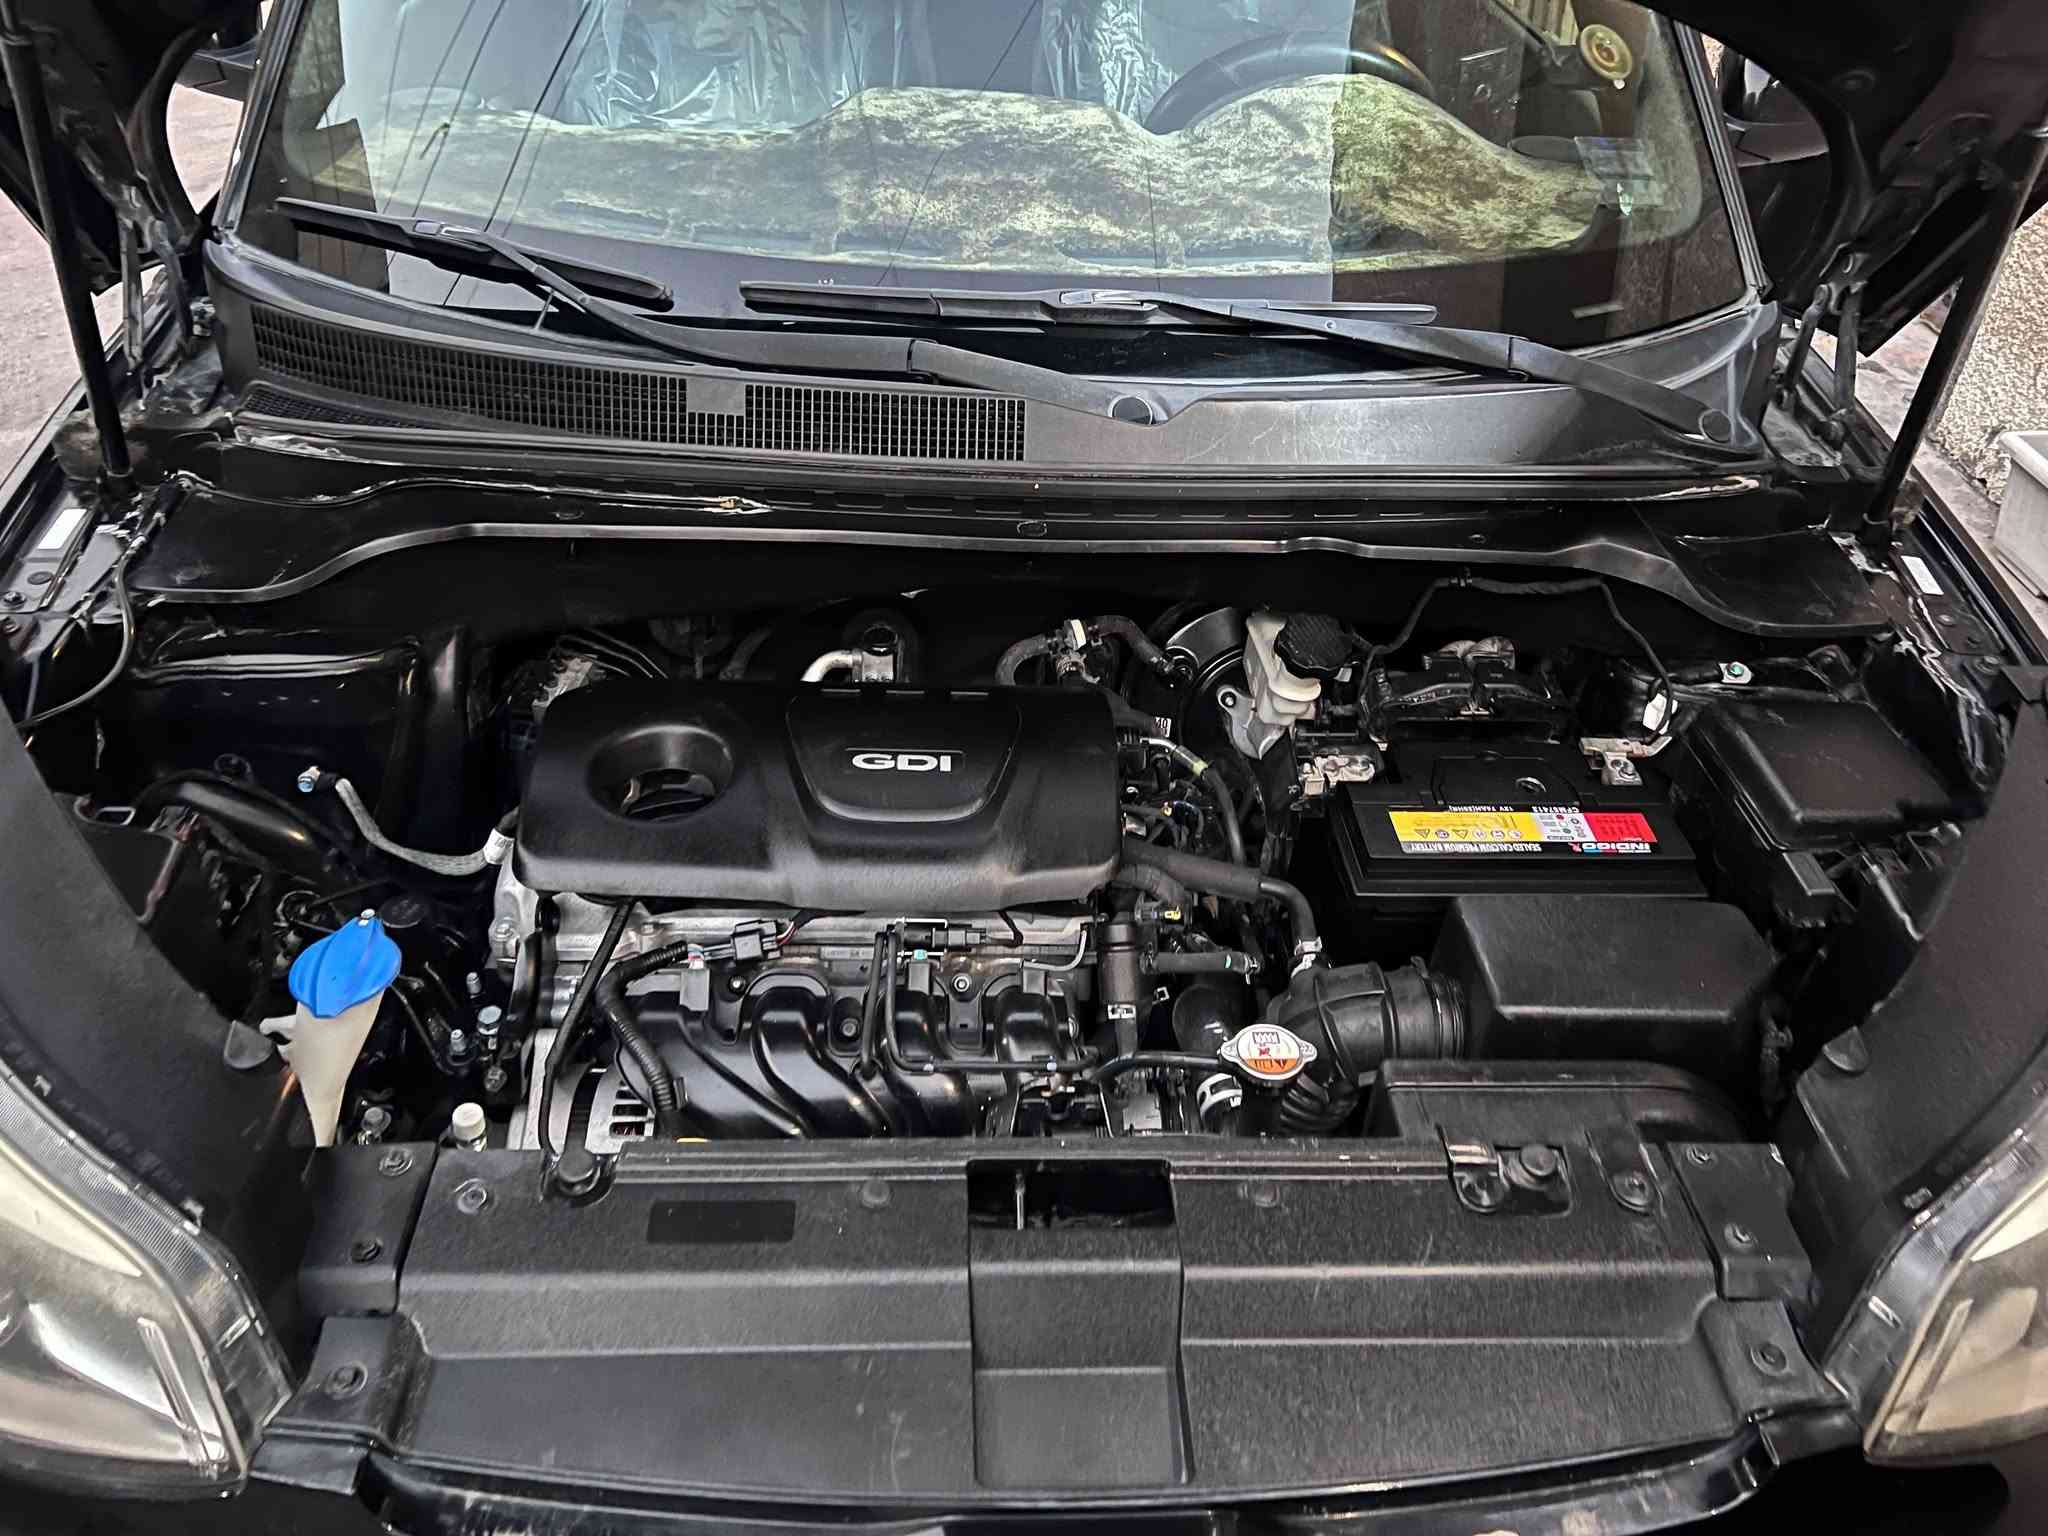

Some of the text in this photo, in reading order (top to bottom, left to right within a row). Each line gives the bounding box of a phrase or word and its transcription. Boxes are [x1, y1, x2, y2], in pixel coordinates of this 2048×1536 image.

[852, 753, 952, 772] GDI
[1410, 842, 1443, 852] BATTERY
[1513, 843, 1542, 852] SEALED
